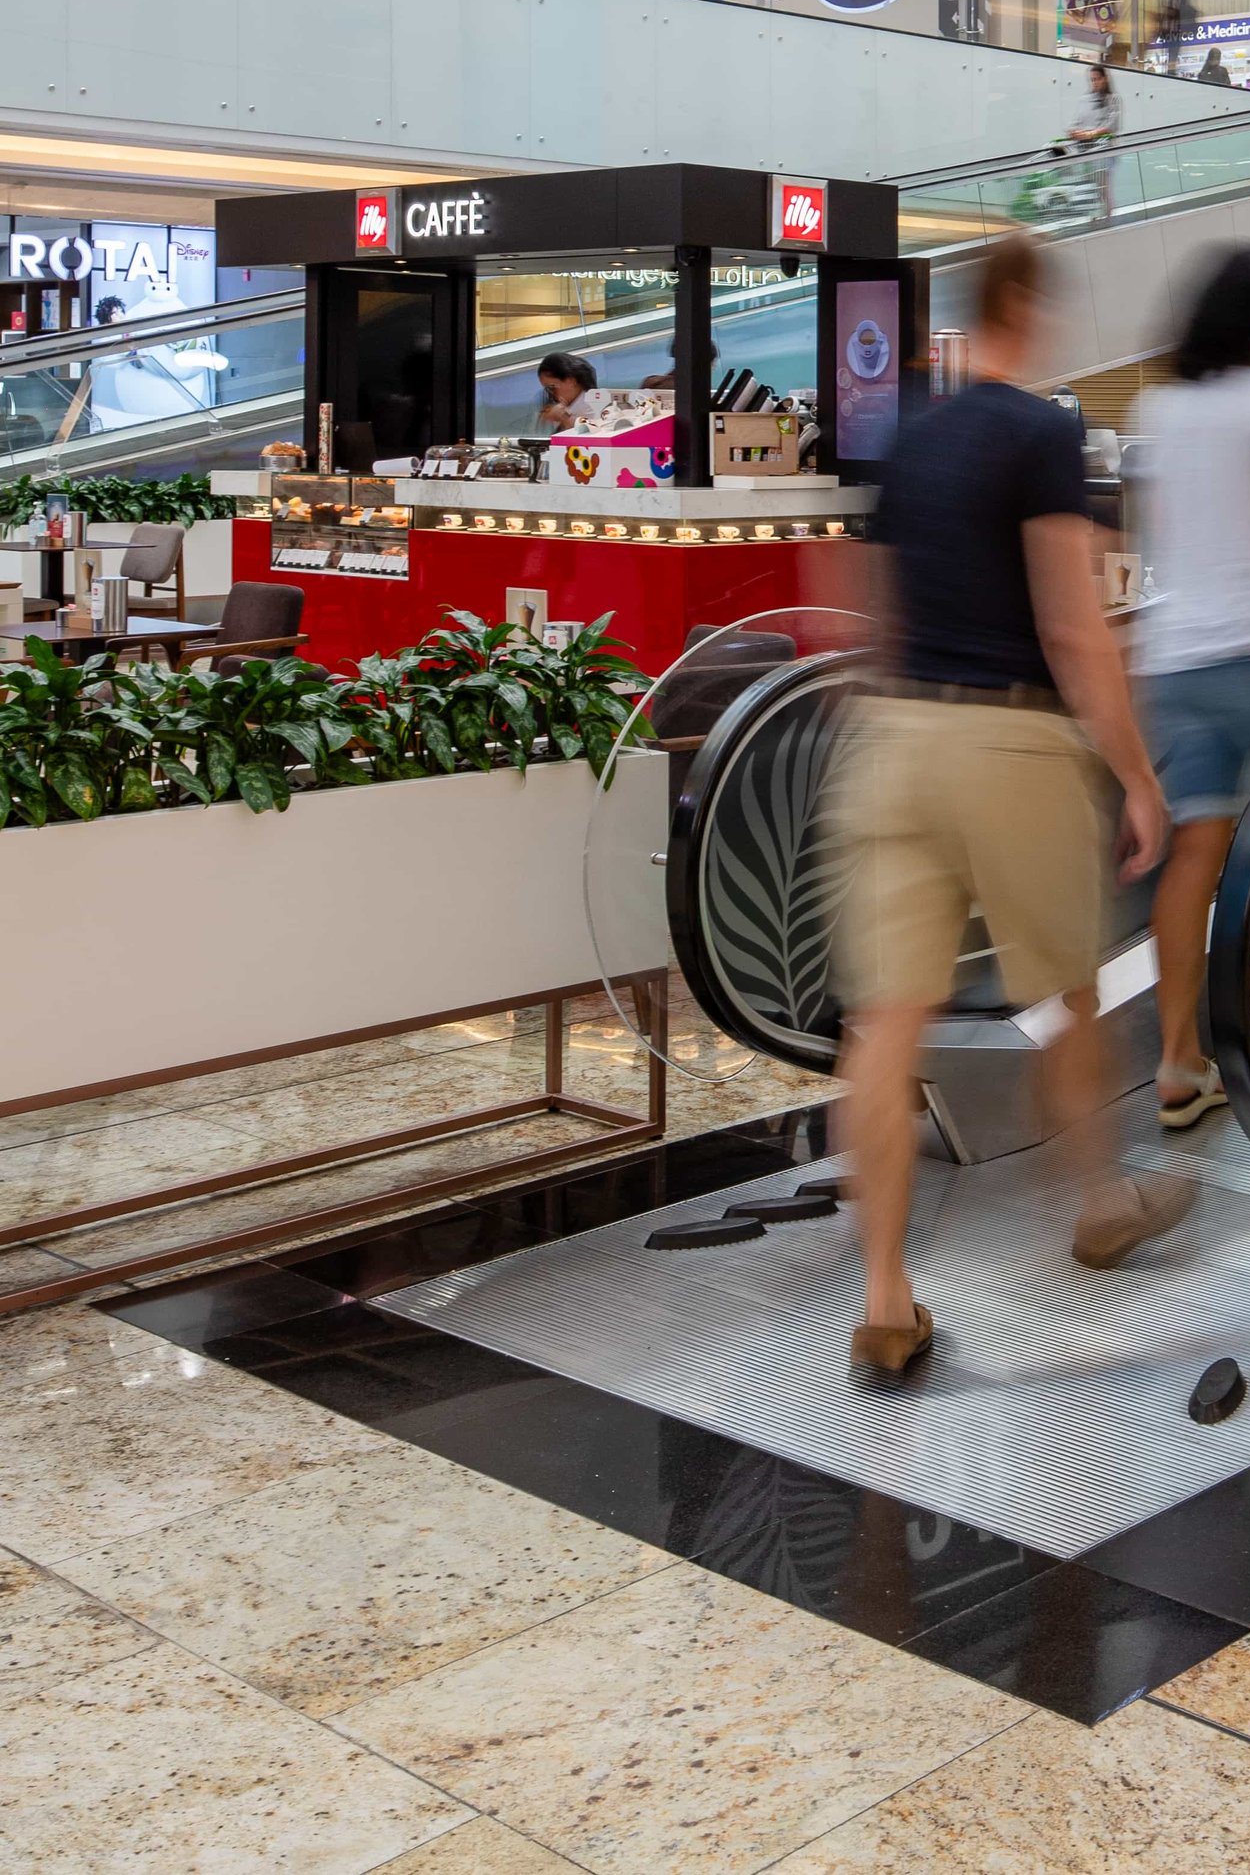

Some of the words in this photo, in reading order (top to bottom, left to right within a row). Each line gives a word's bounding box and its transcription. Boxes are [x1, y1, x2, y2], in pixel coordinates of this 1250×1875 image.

[1196, 26, 1207, 40] &
[360, 204, 387, 240] illy
[406, 192, 485, 238] CAFFÈ
[784, 193, 821, 236] illy
[10, 233, 178, 283] ROTAI
